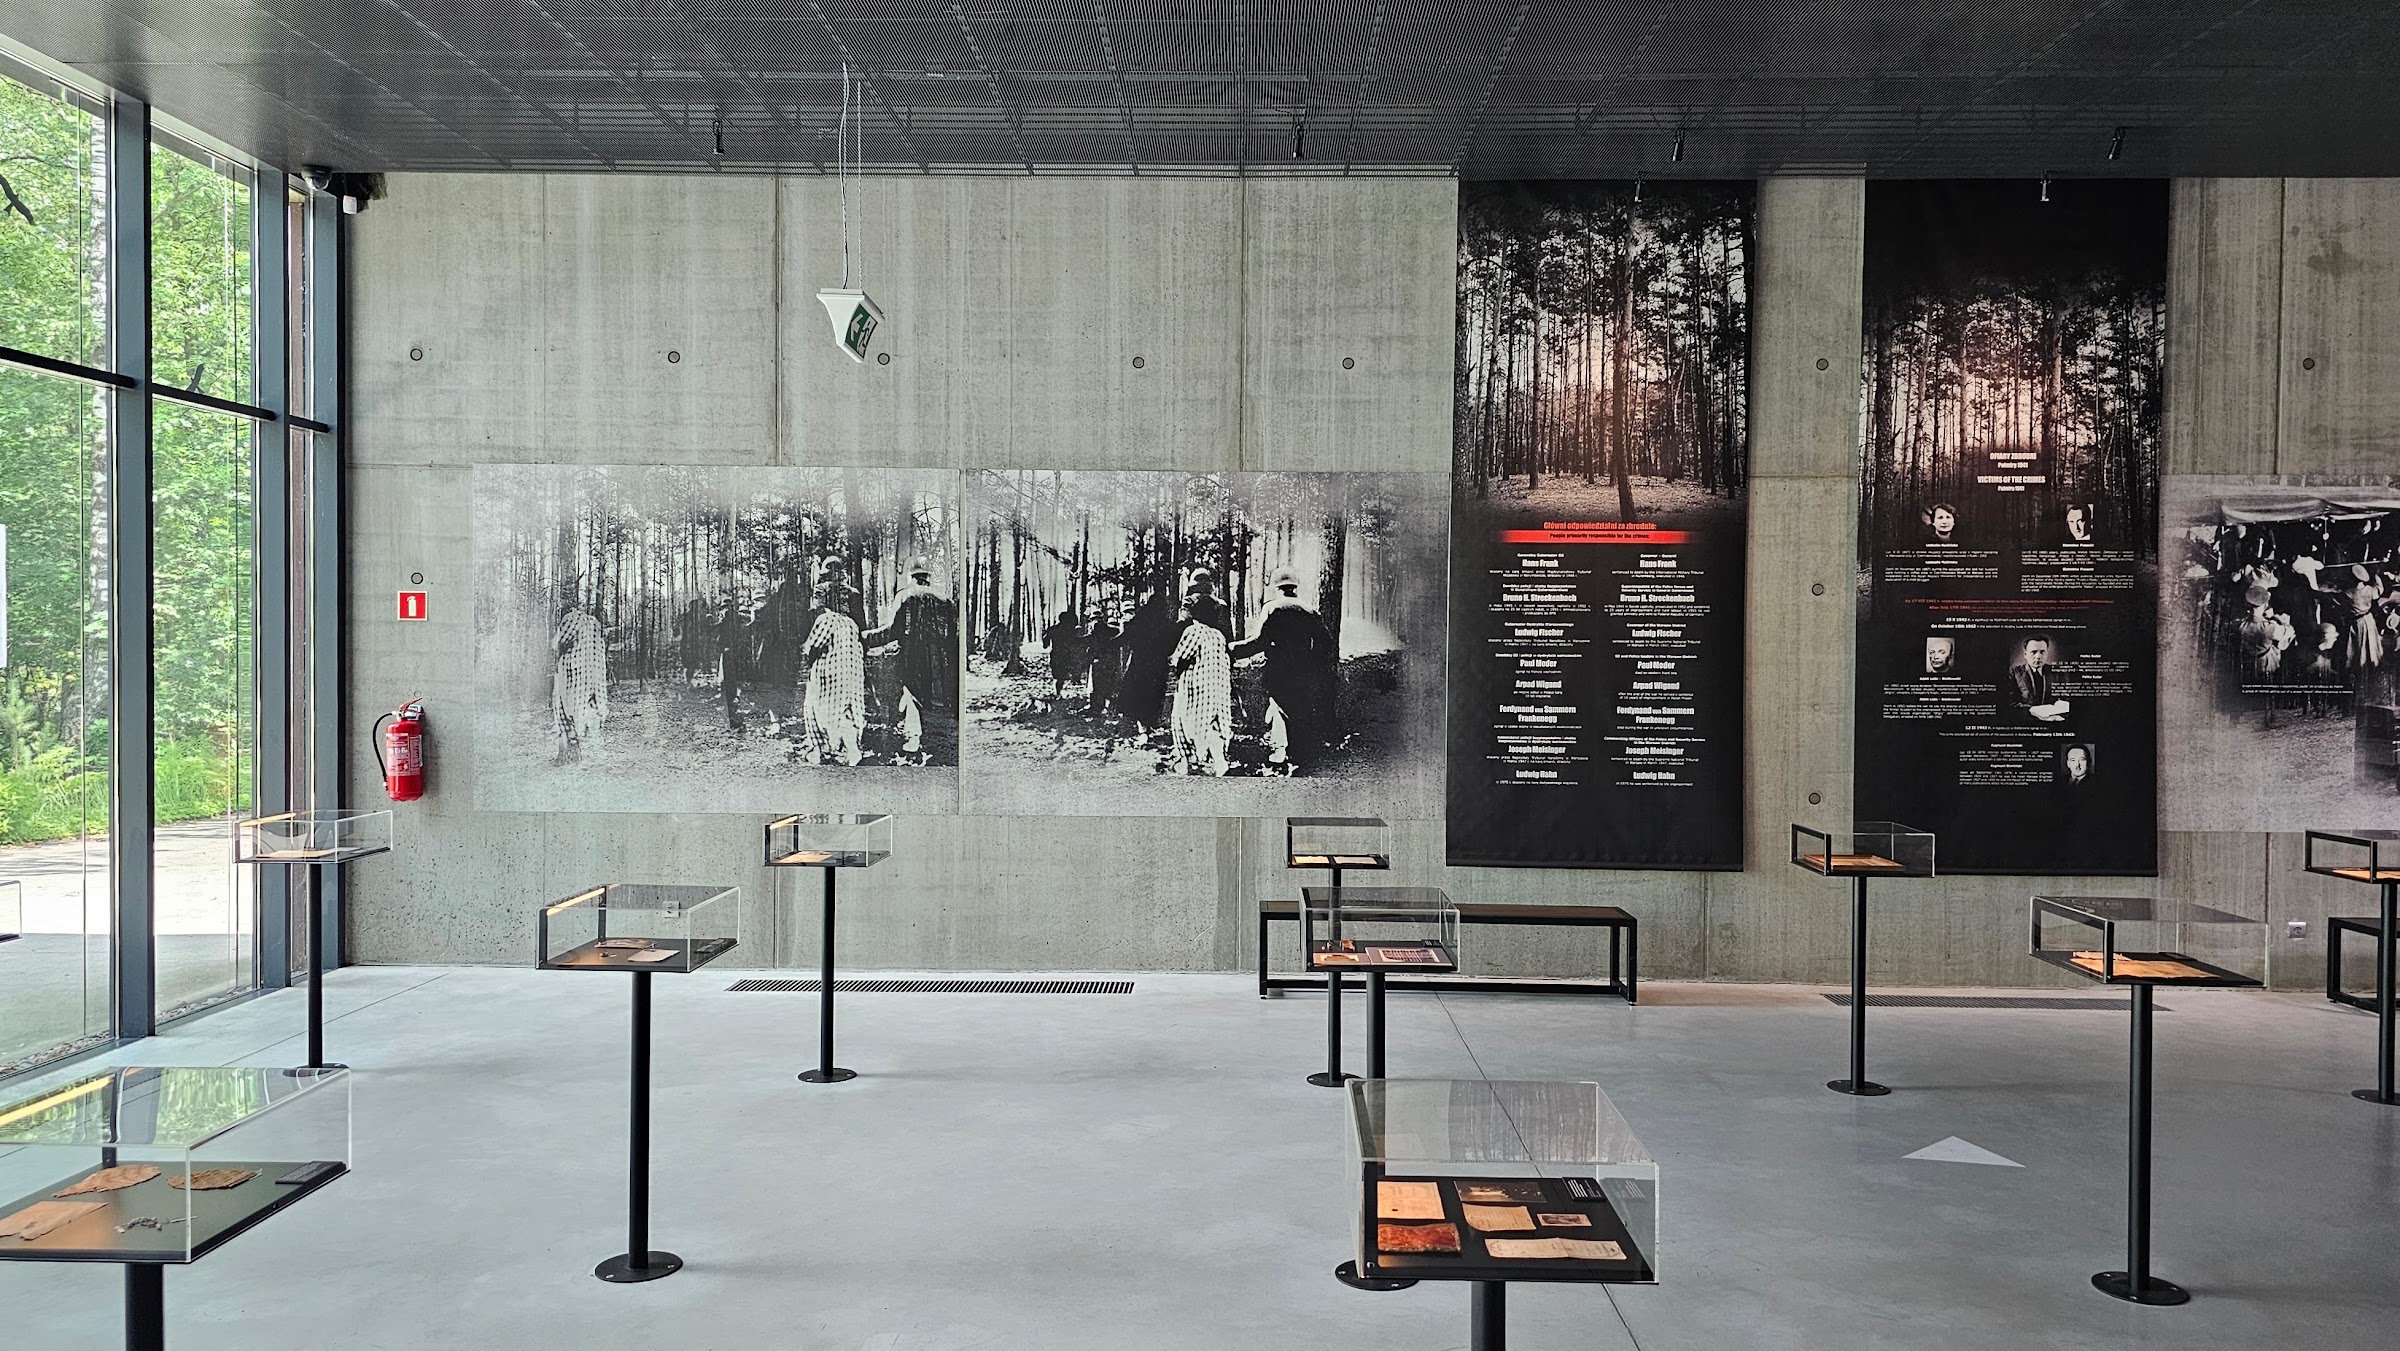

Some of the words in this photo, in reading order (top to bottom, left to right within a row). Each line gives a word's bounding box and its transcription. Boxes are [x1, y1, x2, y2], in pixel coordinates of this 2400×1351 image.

[1522, 559, 1539, 567] Hans
[1540, 559, 1558, 567] Frank
[1620, 594, 1640, 602] Bruno
[1641, 594, 1647, 602] H.
[1515, 629, 1538, 637] Ludwig
[1632, 629, 1656, 637] Ludwig
[1638, 661, 1652, 669] Paul
[1515, 680, 1535, 688] Arpad
[1536, 680, 1561, 689] Wigand
[1633, 682, 1653, 690] Arpad
[1654, 682, 1679, 690] Wigand
[1500, 705, 1534, 713] Ferdynand
[1544, 705, 1576, 713] Sammern
[1617, 706, 1652, 714] Ferdynand
[1508, 745, 1531, 753] Joseph
[1626, 747, 1649, 755] Joseph
[1516, 770, 1539, 779] Ludwig
[1540, 770, 1557, 778] Hahn
[1633, 772, 1657, 780] Ludwig
